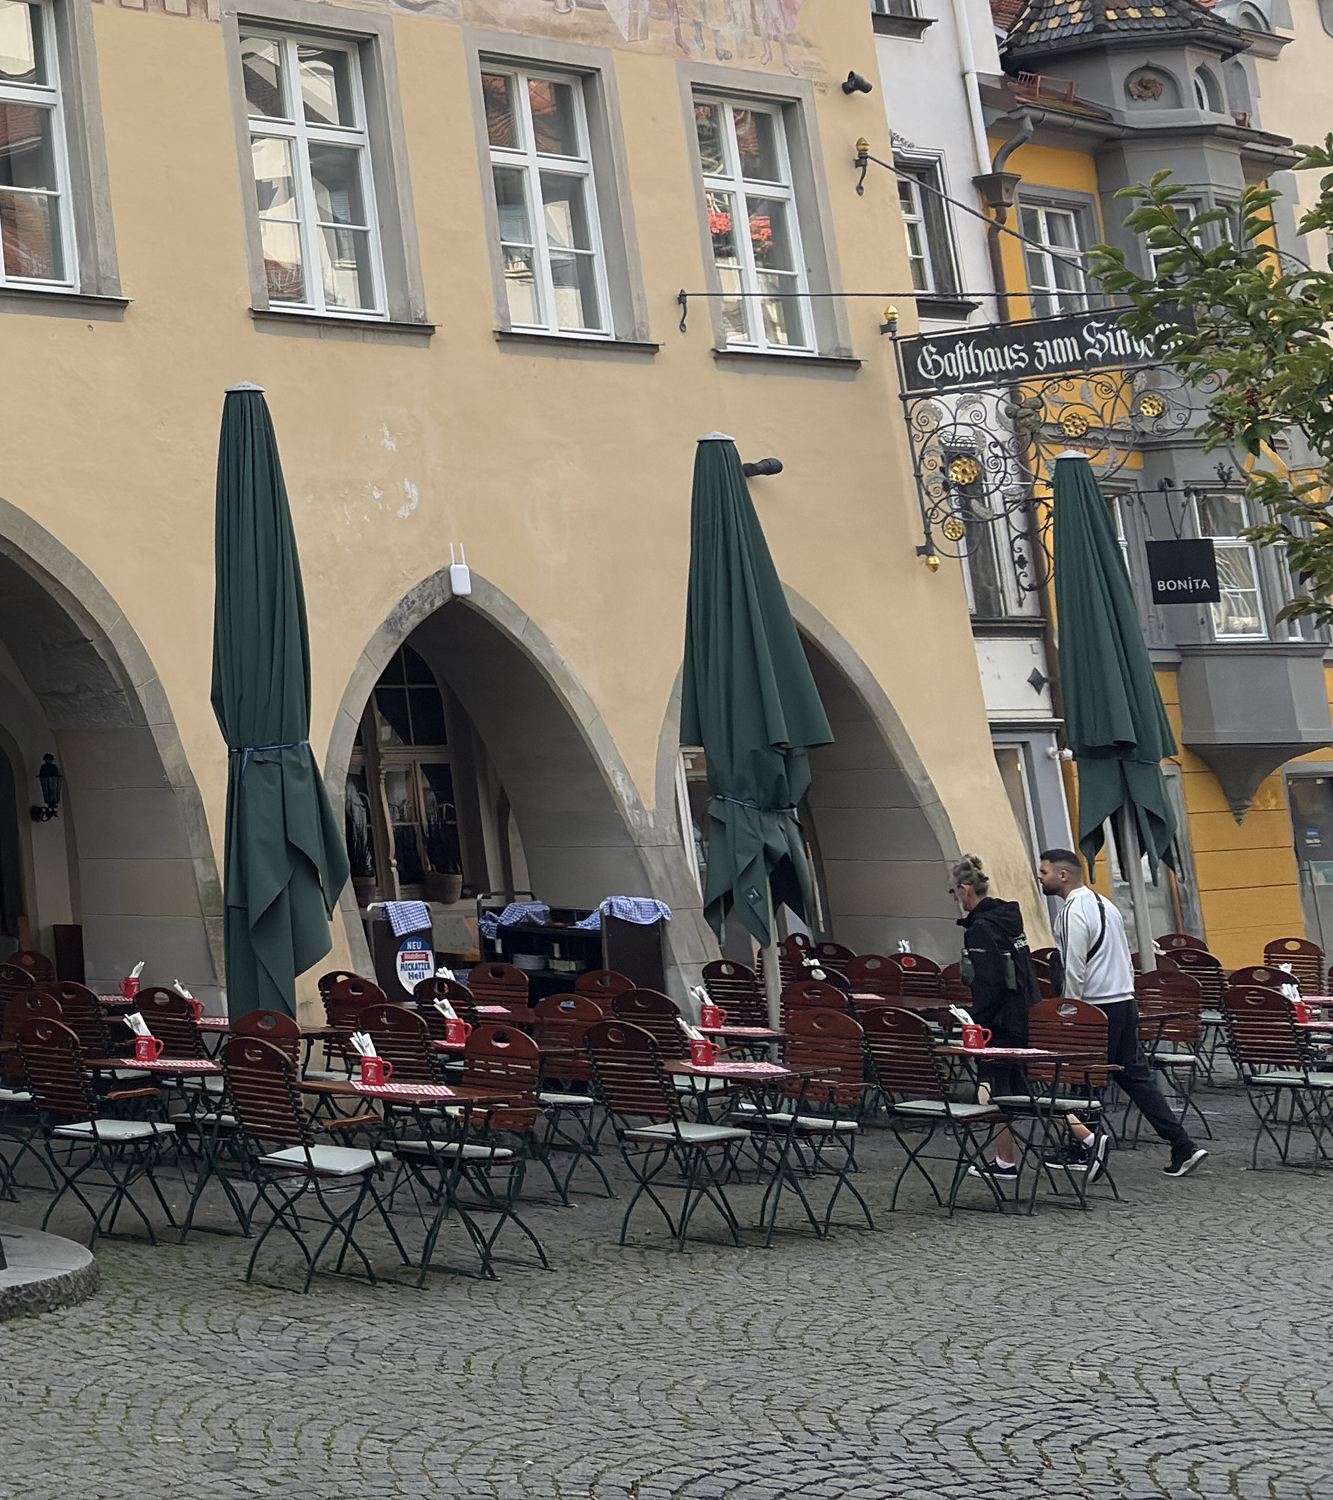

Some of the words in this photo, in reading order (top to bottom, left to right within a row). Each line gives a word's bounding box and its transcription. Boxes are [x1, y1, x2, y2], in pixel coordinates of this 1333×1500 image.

[1033, 335, 1082, 370] zum
[407, 941, 422, 950] NEU
[400, 962, 431, 972] MECKATZER
[408, 971, 425, 980] Hell
